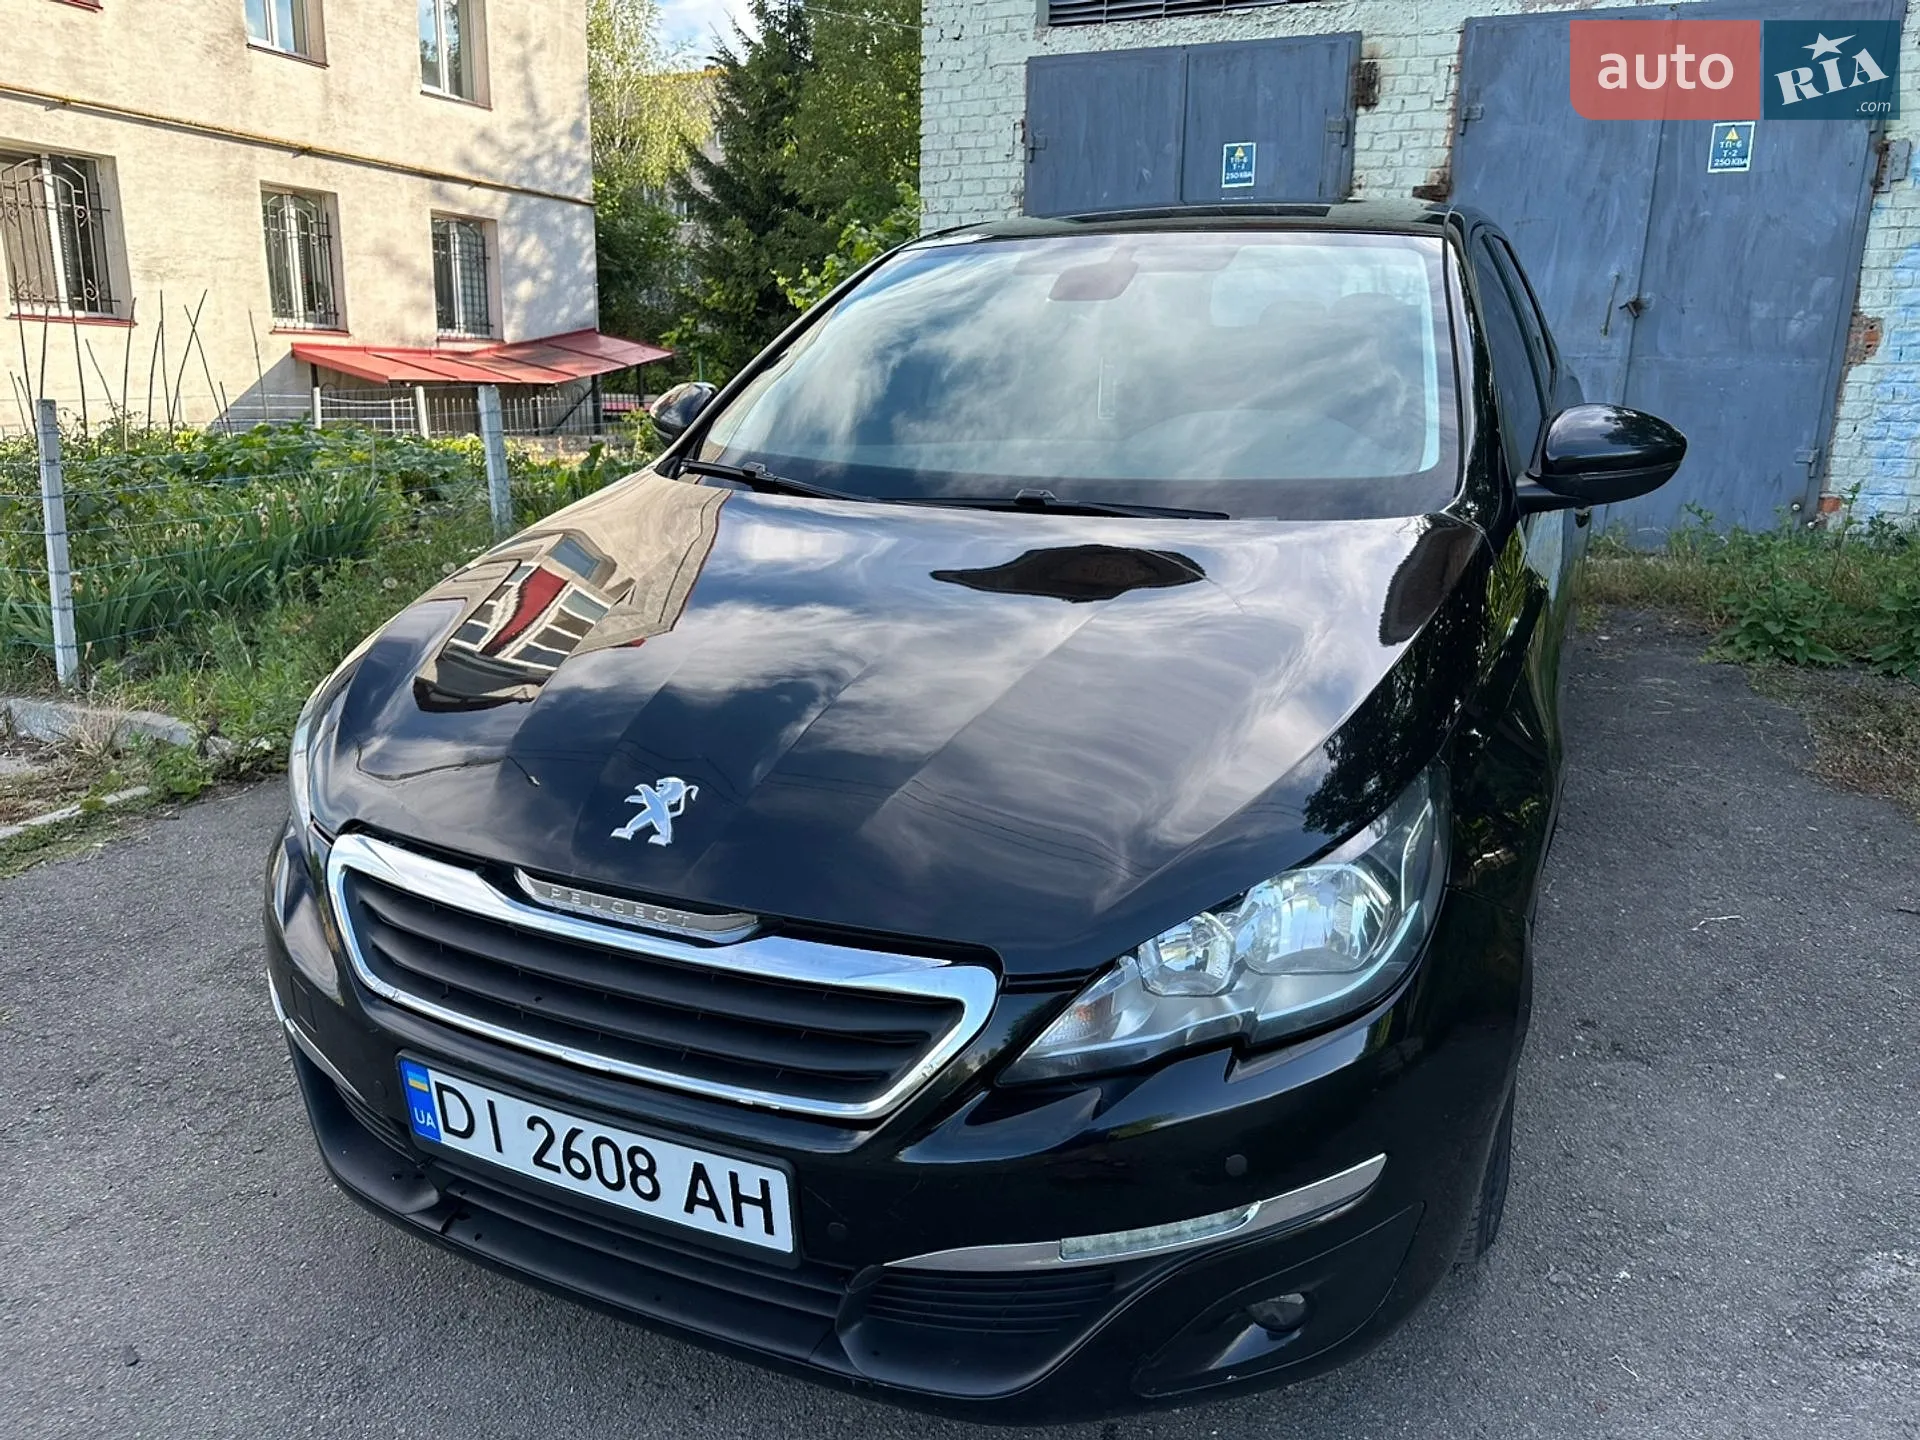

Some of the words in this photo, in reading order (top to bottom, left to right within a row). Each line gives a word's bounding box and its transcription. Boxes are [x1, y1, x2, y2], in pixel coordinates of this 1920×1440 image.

[414, 1107, 436, 1129] UA
[434, 1080, 503, 1154] DI
[526, 1115, 661, 1202] 2608
[683, 1161, 775, 1236] AH
